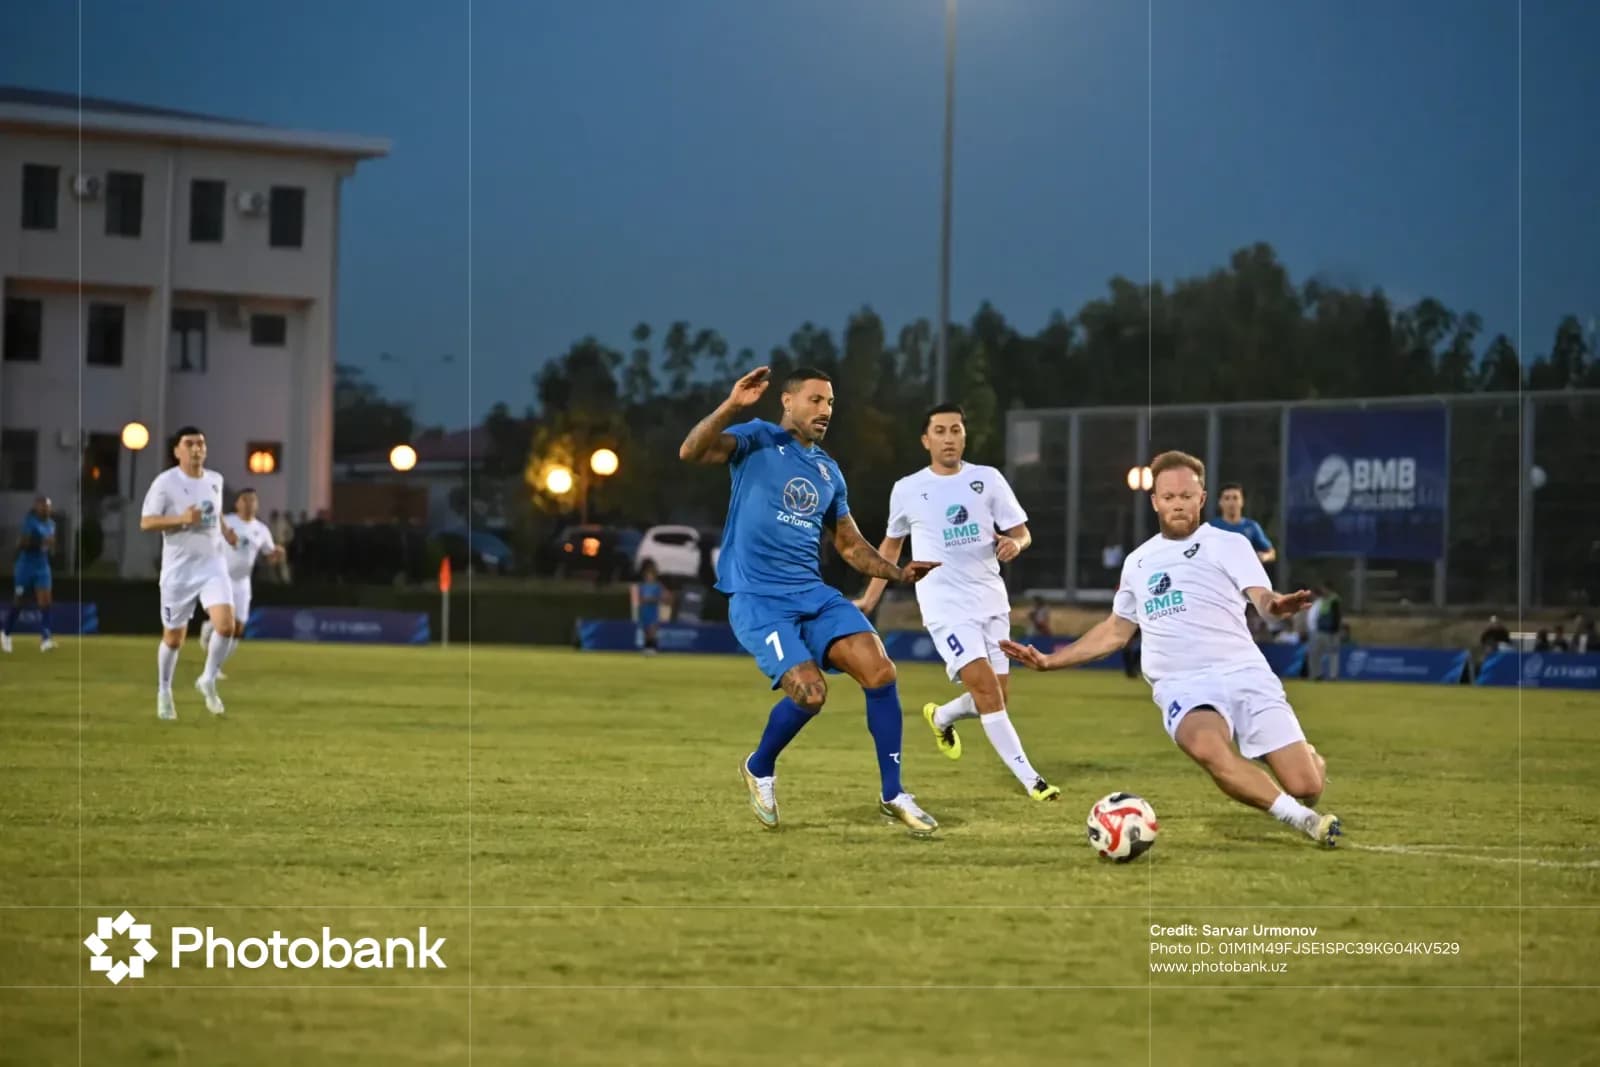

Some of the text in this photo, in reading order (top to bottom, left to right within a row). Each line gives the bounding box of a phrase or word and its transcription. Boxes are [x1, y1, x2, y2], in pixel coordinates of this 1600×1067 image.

[1353, 458, 1416, 490] BMB
[943, 523, 980, 541] BMB
[1144, 590, 1184, 615] BMB
[946, 633, 965, 657] 9
